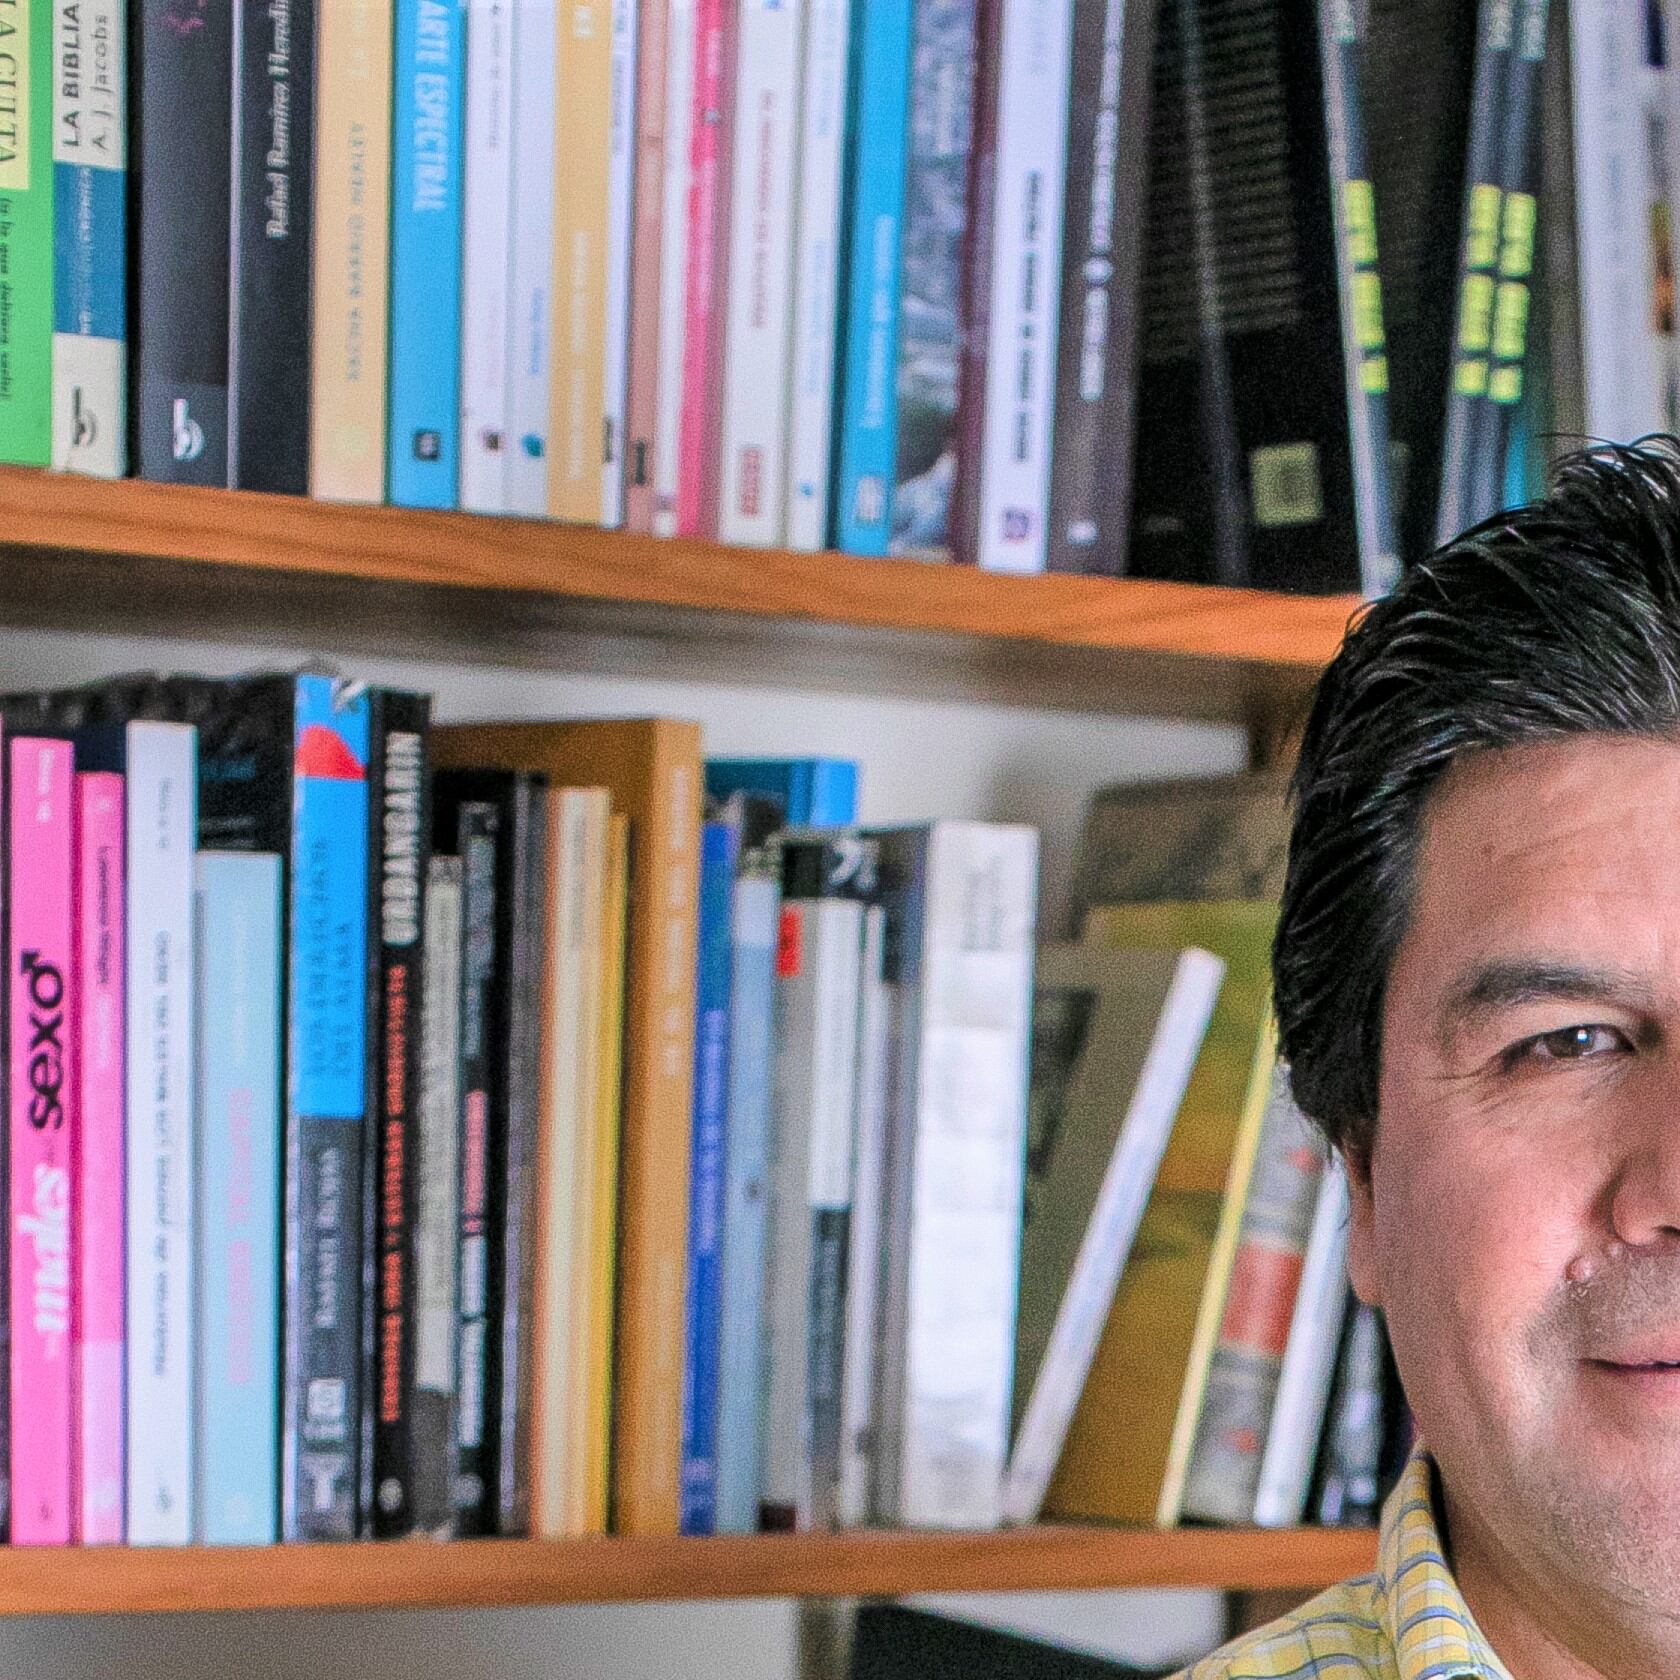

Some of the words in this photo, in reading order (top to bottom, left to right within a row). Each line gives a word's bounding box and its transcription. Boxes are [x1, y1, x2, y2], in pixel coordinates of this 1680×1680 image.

[62, 3, 81, 99] BIBLIA
[266, 0, 290, 76] Heredi
[62, 110, 80, 148] LA
[413, 72, 449, 213] ESPECTRAL
[17, 1164, 69, 1334] males
